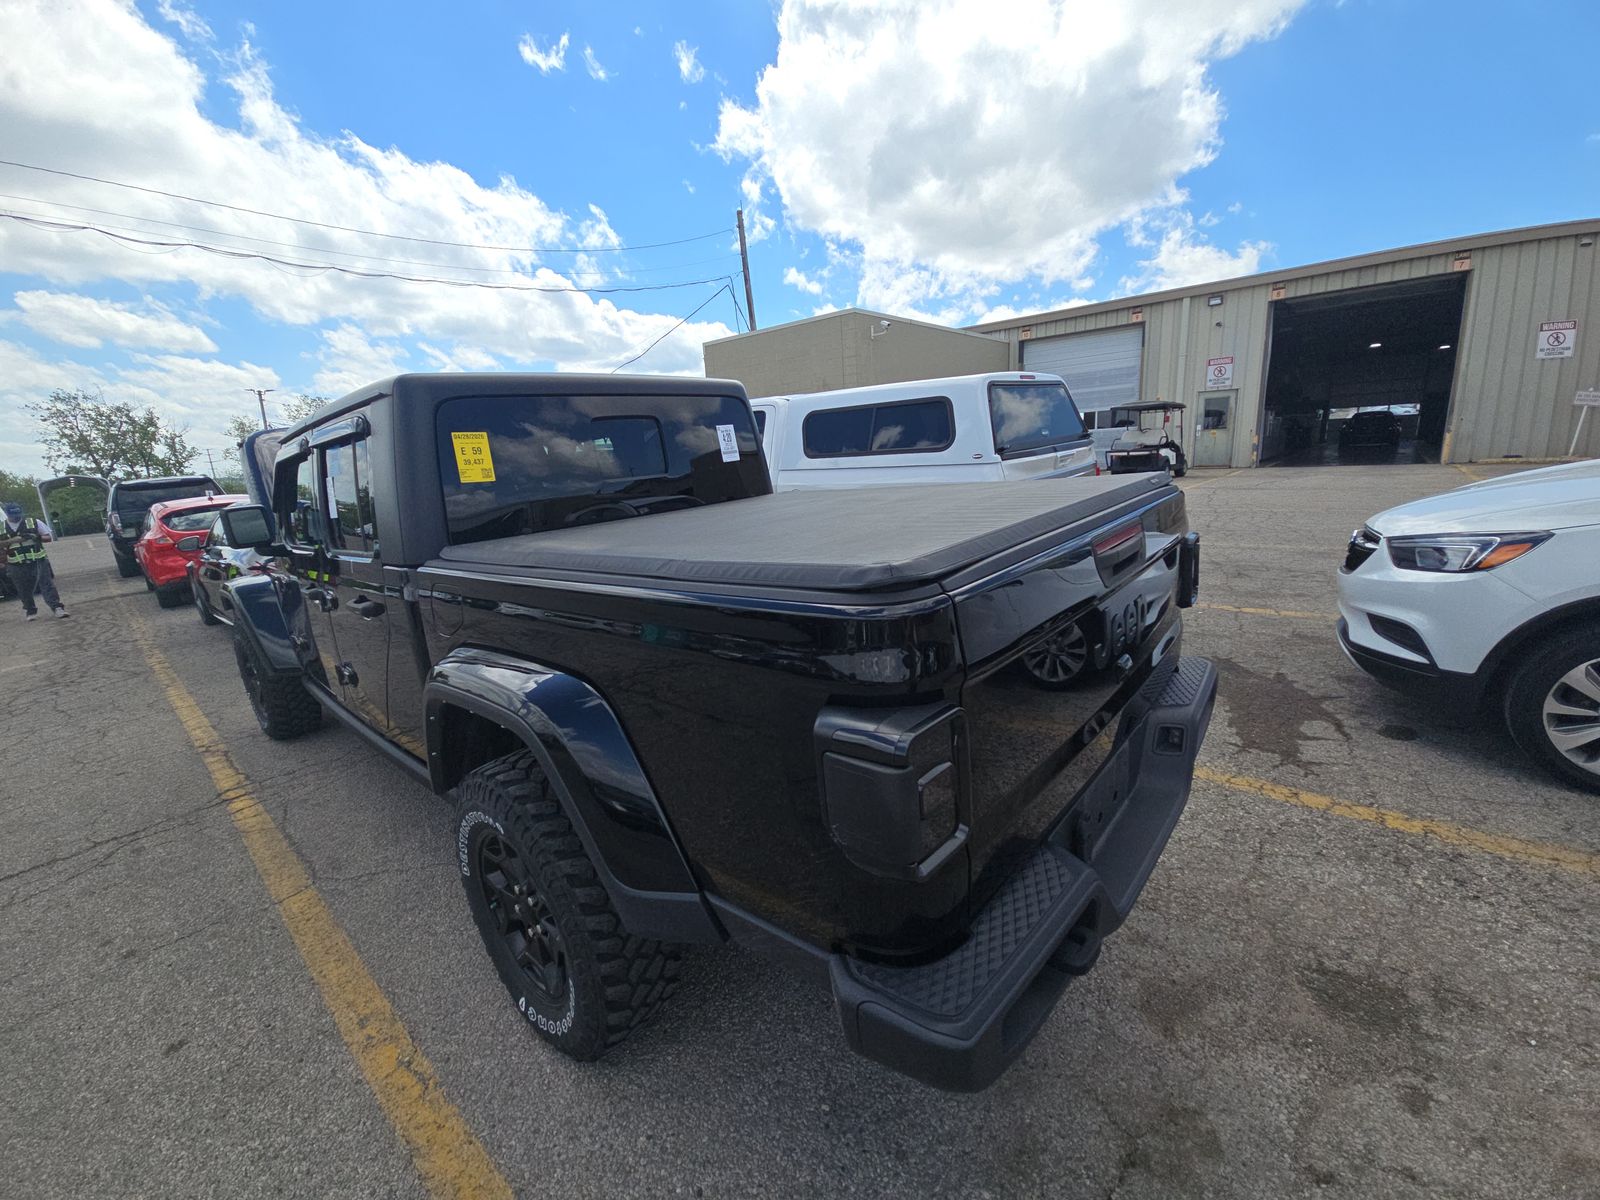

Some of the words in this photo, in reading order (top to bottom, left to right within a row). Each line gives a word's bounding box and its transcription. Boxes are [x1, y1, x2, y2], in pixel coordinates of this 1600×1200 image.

[1542, 321, 1575, 330] WARNING
[1210, 357, 1232, 365] WARNING
[461, 447, 466, 455] E
[472, 446, 482, 455] 59
